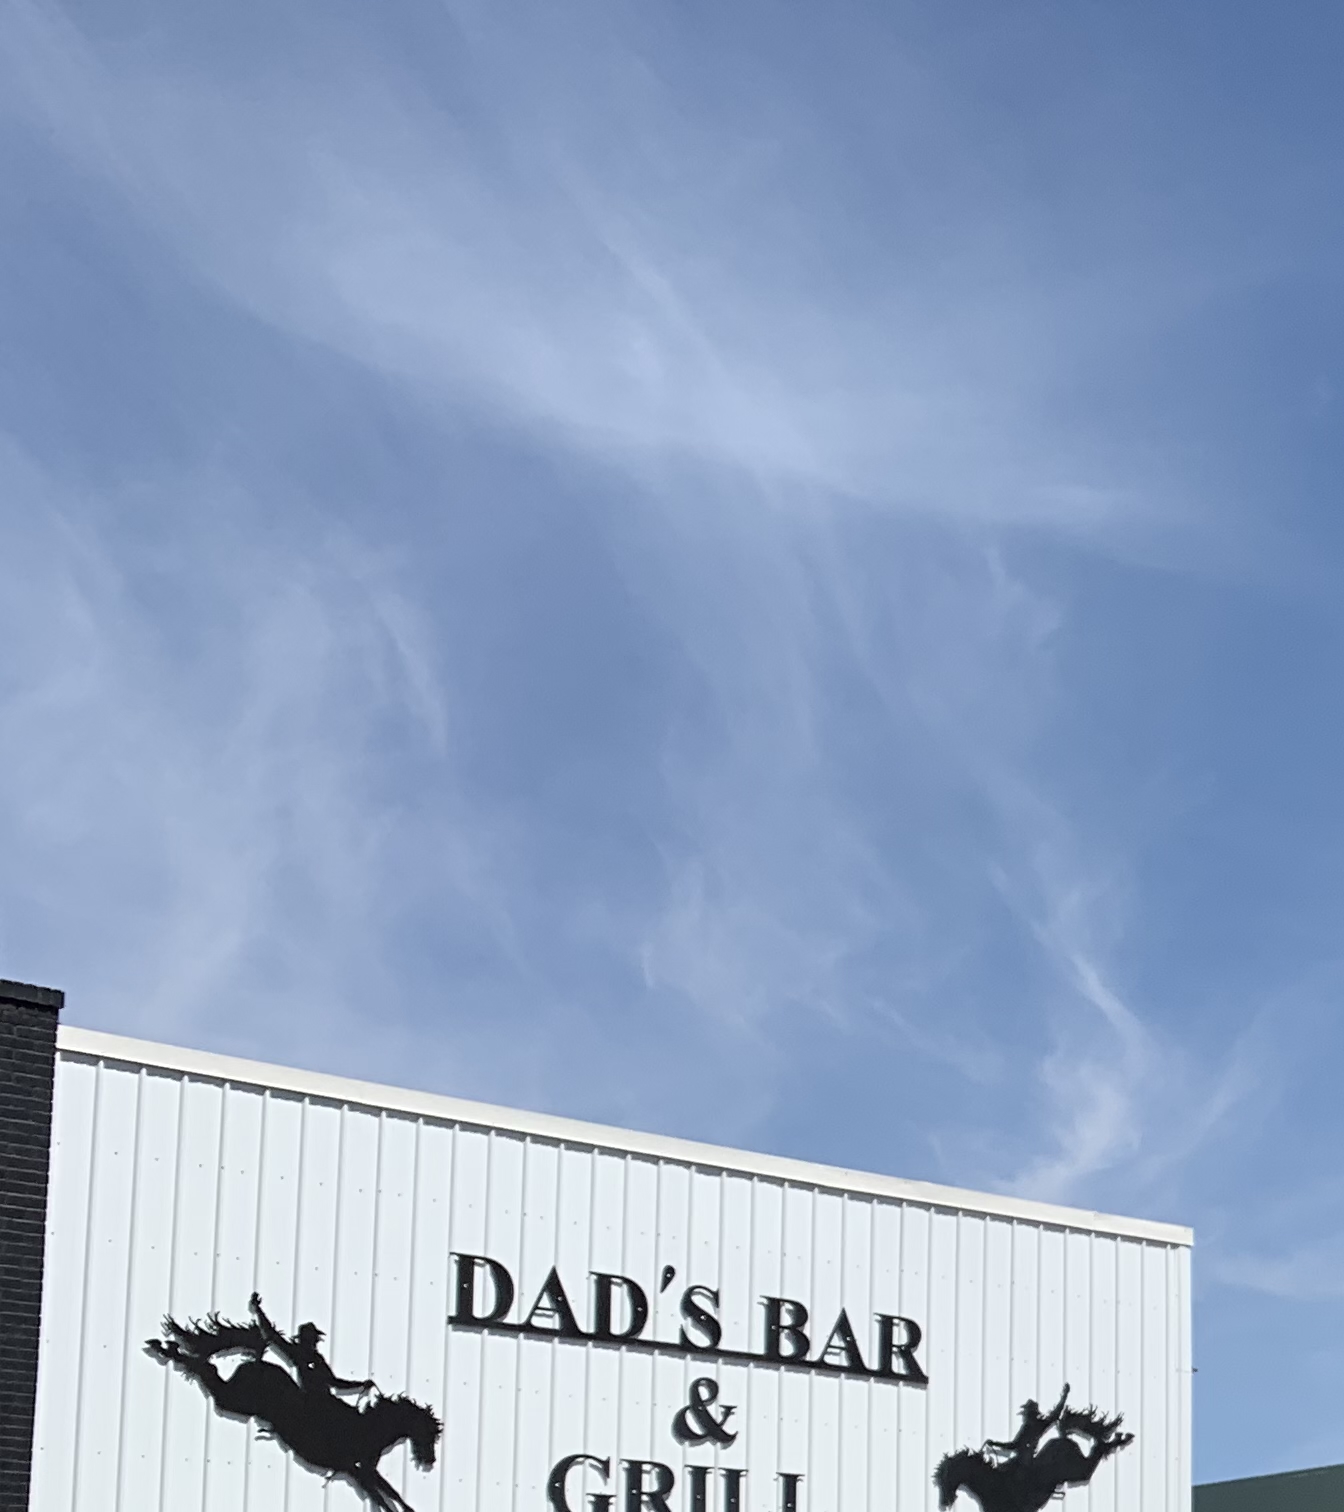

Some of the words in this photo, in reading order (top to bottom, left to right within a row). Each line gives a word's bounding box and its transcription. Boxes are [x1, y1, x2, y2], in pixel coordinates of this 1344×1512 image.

[448, 1252, 723, 1354] DAD'S
[759, 1294, 929, 1383] BAR
[671, 1376, 739, 1444] &
